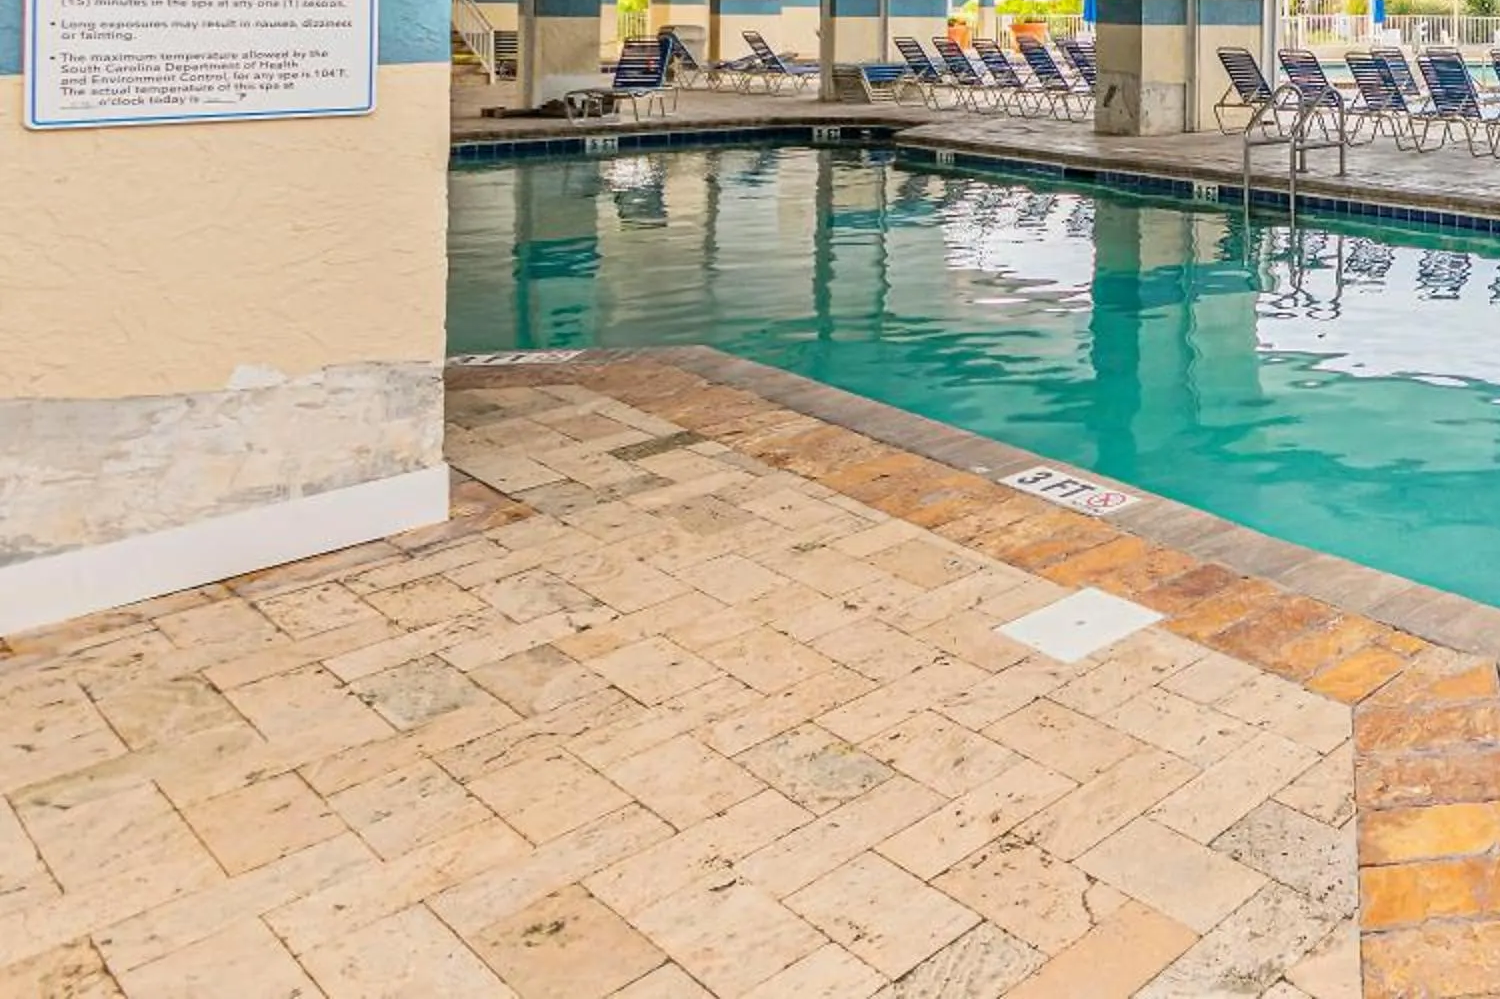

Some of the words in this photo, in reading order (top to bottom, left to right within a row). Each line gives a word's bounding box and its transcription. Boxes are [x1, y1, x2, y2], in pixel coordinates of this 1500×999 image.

[61, 64, 100, 74] South
[105, 63, 161, 73] Carolina
[165, 61, 241, 73] Department
[1017, 471, 1053, 485] 3
[1040, 478, 1096, 499] FT
